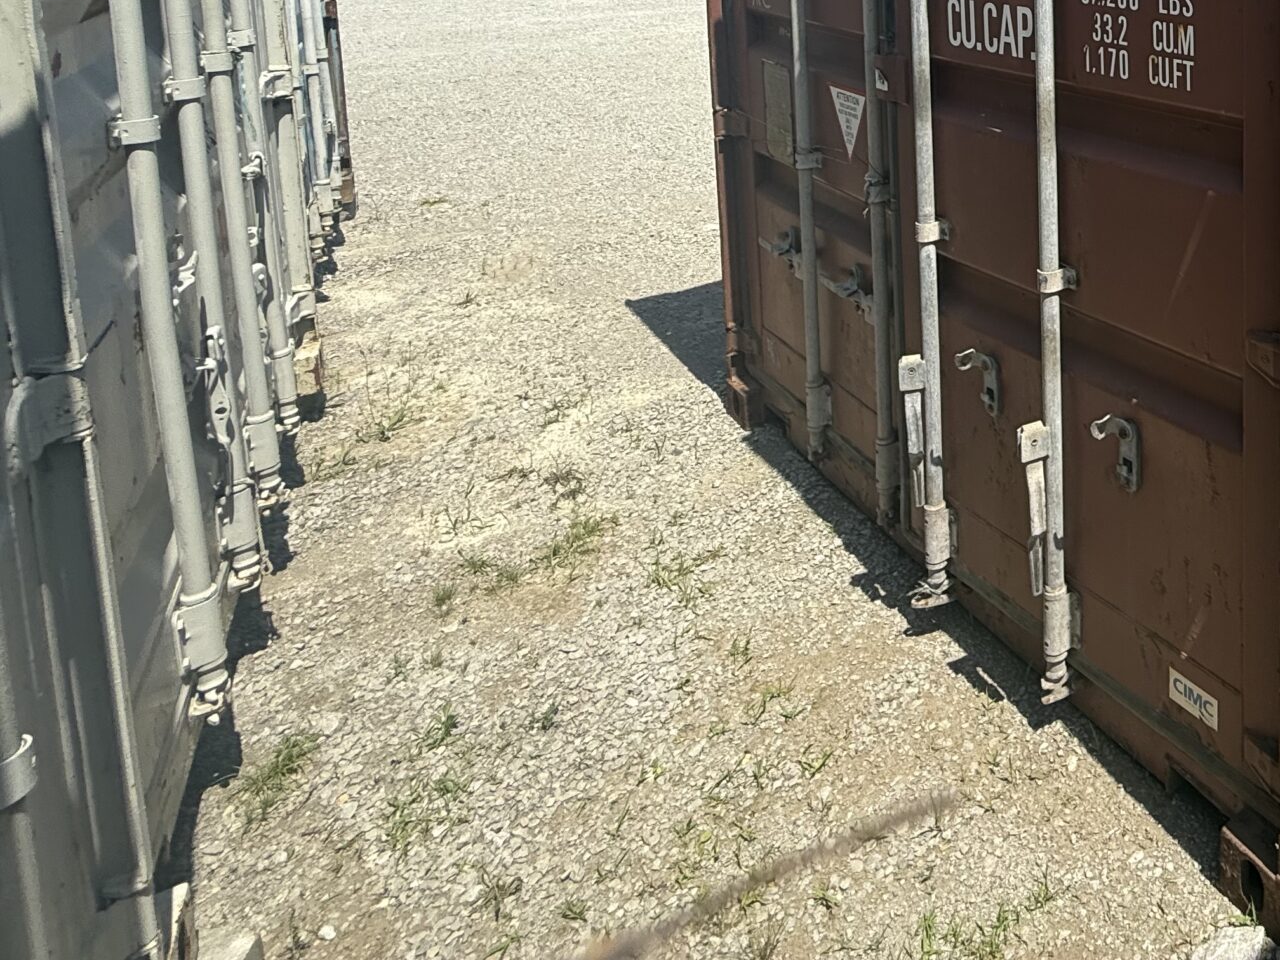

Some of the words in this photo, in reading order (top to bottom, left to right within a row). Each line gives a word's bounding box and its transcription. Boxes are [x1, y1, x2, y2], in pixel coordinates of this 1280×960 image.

[1092, 12, 1128, 46] 33.2
[1153, 21, 1195, 56] CU.M
[1083, 44, 1129, 80] 1,170
[1148, 55, 1194, 92] CU.FT
[1173, 677, 1214, 718] CIMC
